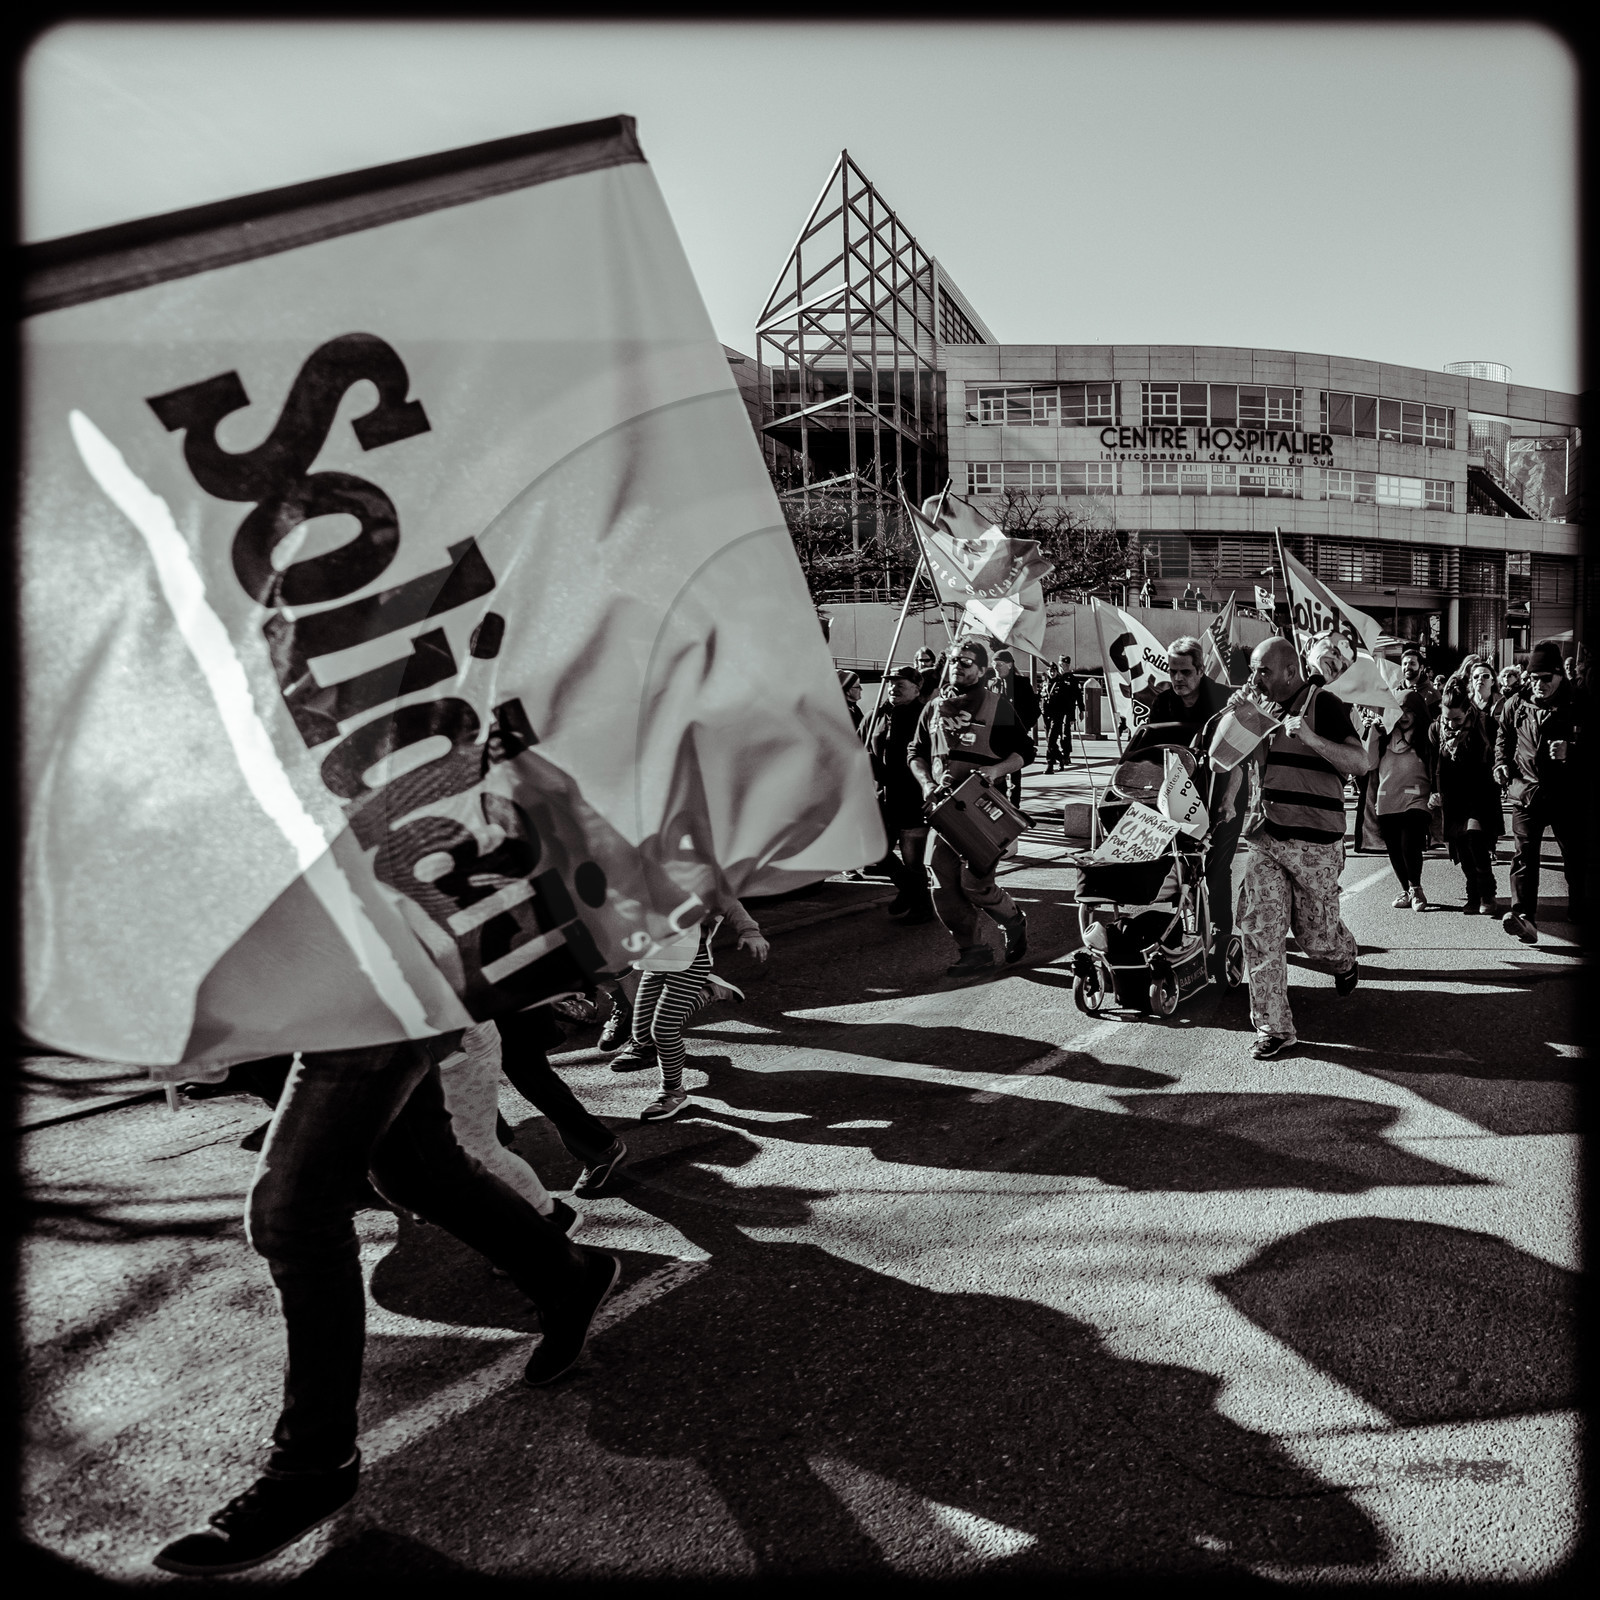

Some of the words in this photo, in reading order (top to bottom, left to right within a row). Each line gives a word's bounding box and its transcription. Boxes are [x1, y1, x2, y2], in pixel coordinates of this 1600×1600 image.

[1100, 427, 1187, 449] CENTRE
[1197, 428, 1333, 455] HOSPITALIER
[1100, 451, 1197, 461] Intercommunal
[1209, 452, 1231, 462] des
[1242, 452, 1278, 464] Alpes
[1288, 455, 1303, 465] du
[1313, 456, 1334, 467] Sud
[1180, 777, 1192, 797] PO
[1132, 827, 1167, 853] MORT
